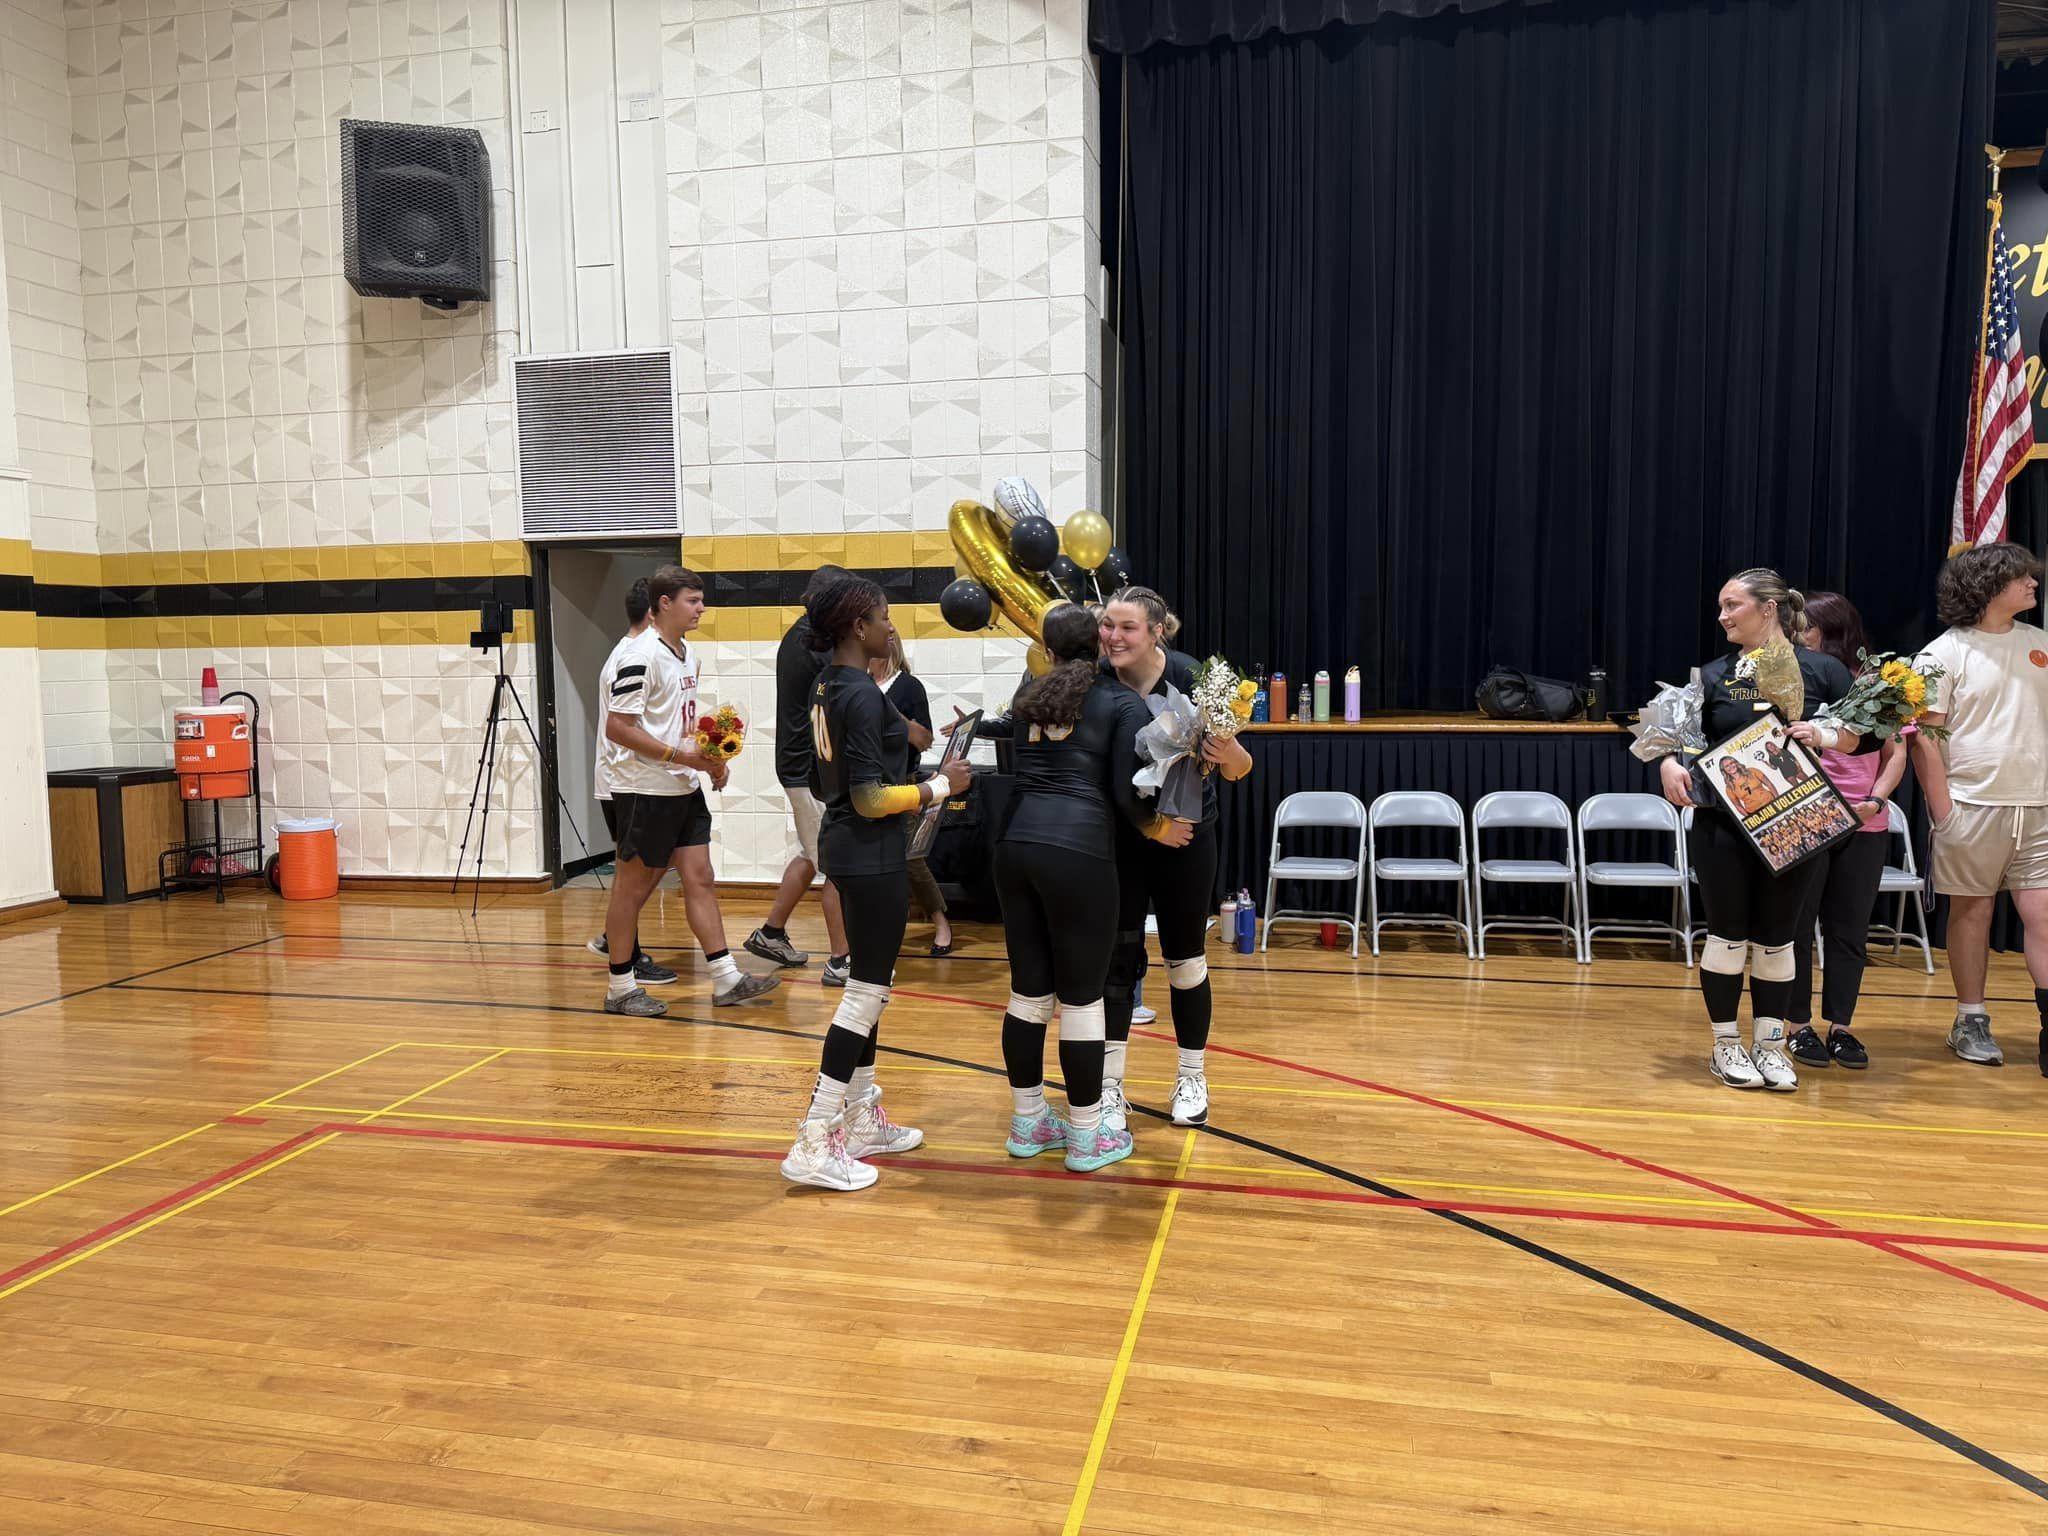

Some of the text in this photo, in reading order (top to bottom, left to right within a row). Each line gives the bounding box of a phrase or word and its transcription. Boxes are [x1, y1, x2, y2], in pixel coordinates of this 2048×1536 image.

[1730, 688, 1766, 701] TRO
[810, 704, 833, 762] 10
[1744, 776, 1825, 830] TROJAN VOLLEYBALL
